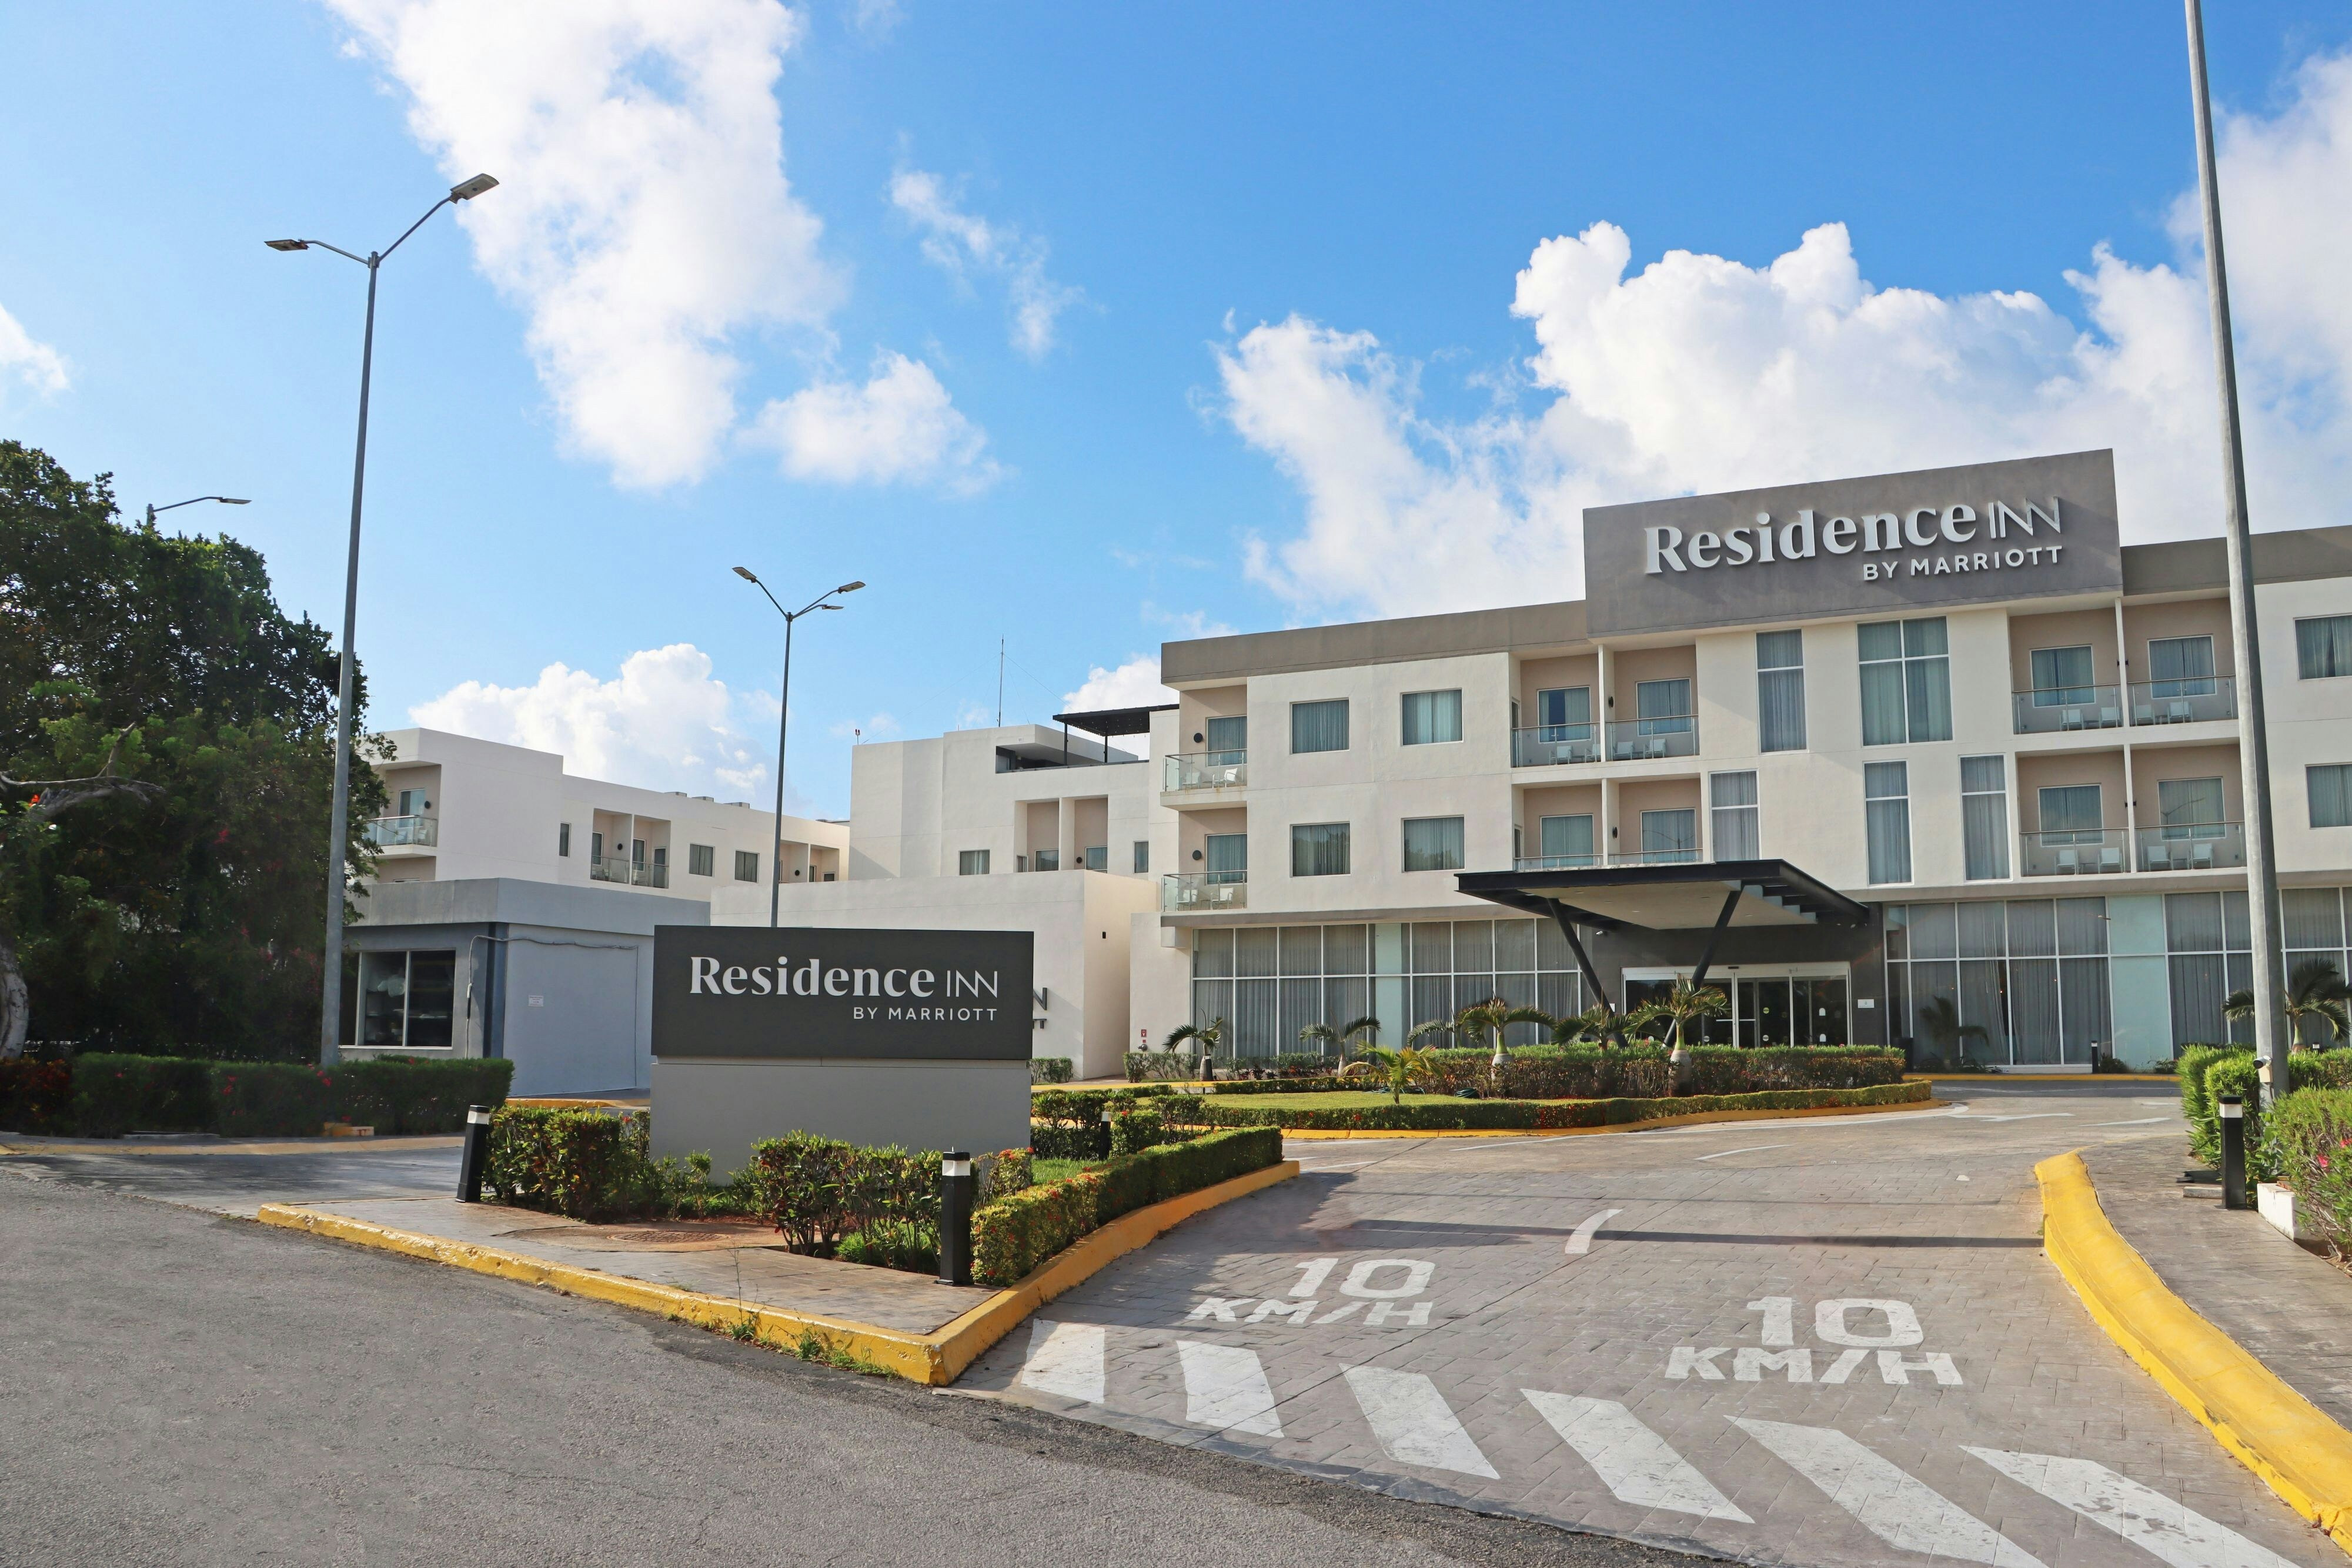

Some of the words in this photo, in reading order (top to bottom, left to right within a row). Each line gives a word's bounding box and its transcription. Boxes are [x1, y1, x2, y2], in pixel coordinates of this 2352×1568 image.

[1645, 503, 1976, 574] Residence
[1988, 496, 2060, 539] INN
[1863, 561, 1899, 581] BY
[1910, 545, 2063, 576] MARRIOTT
[689, 956, 935, 998] Residence
[946, 970, 998, 998] INN
[853, 1007, 878, 1019] BY
[888, 1007, 997, 1021] MARRIOTT
[1288, 1258, 1435, 1298] 10
[1185, 1297, 1434, 1325] KM/H
[1746, 1296, 1923, 1347] 10
[1665, 1346, 1969, 1385] KM/H
